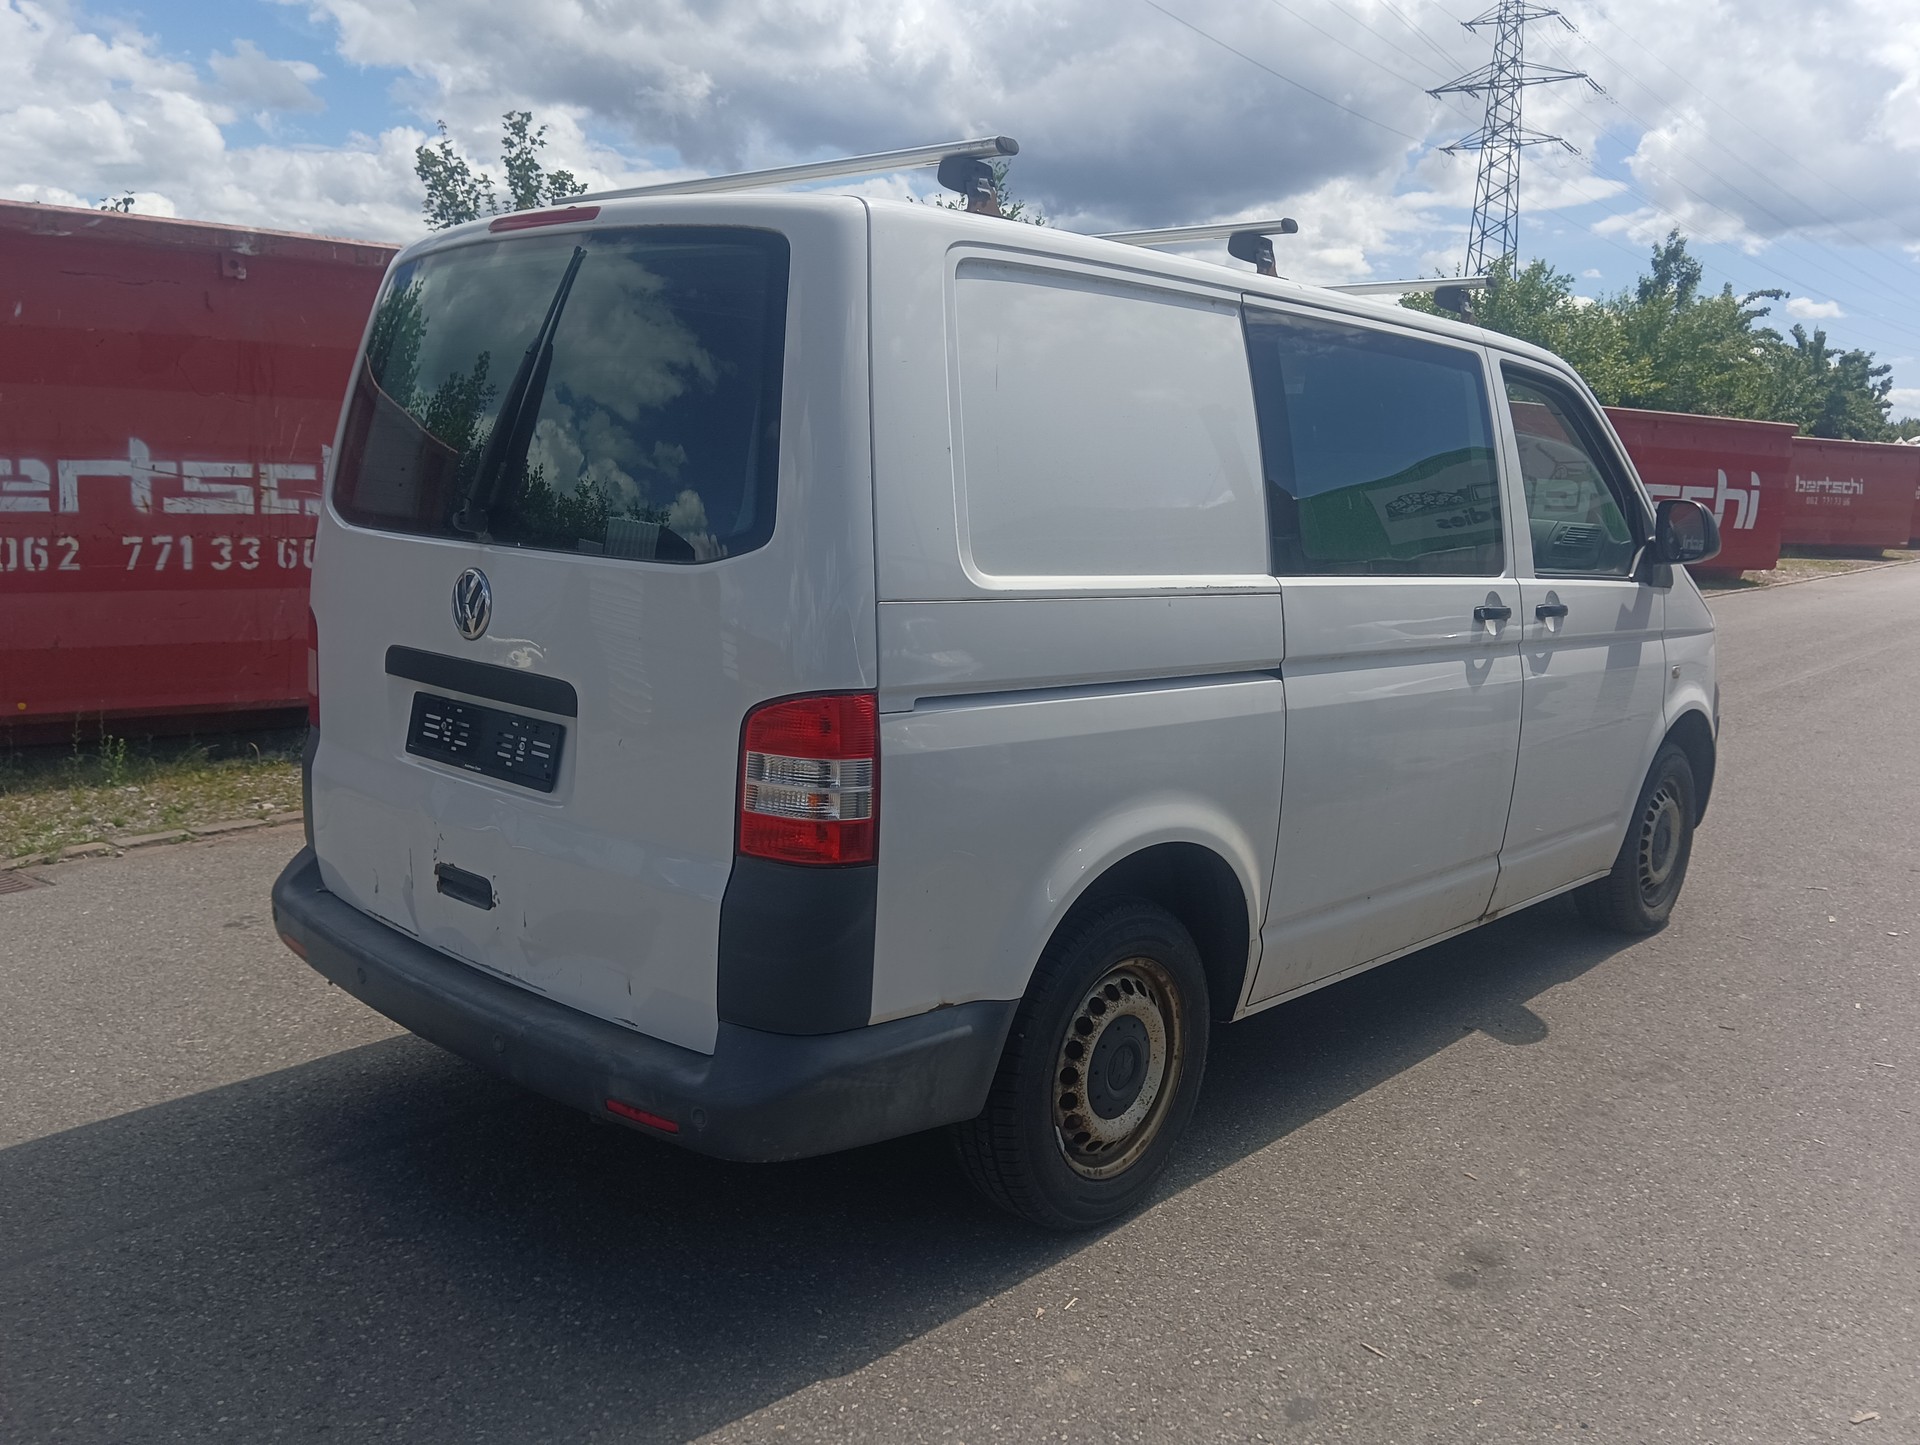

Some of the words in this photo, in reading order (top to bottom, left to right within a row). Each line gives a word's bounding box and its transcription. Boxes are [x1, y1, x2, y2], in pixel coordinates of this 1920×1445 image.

[1795, 474, 1864, 495] bertschi
[0, 536, 81, 571] 062
[122, 536, 194, 571] 771
[211, 537, 261, 571] 33
